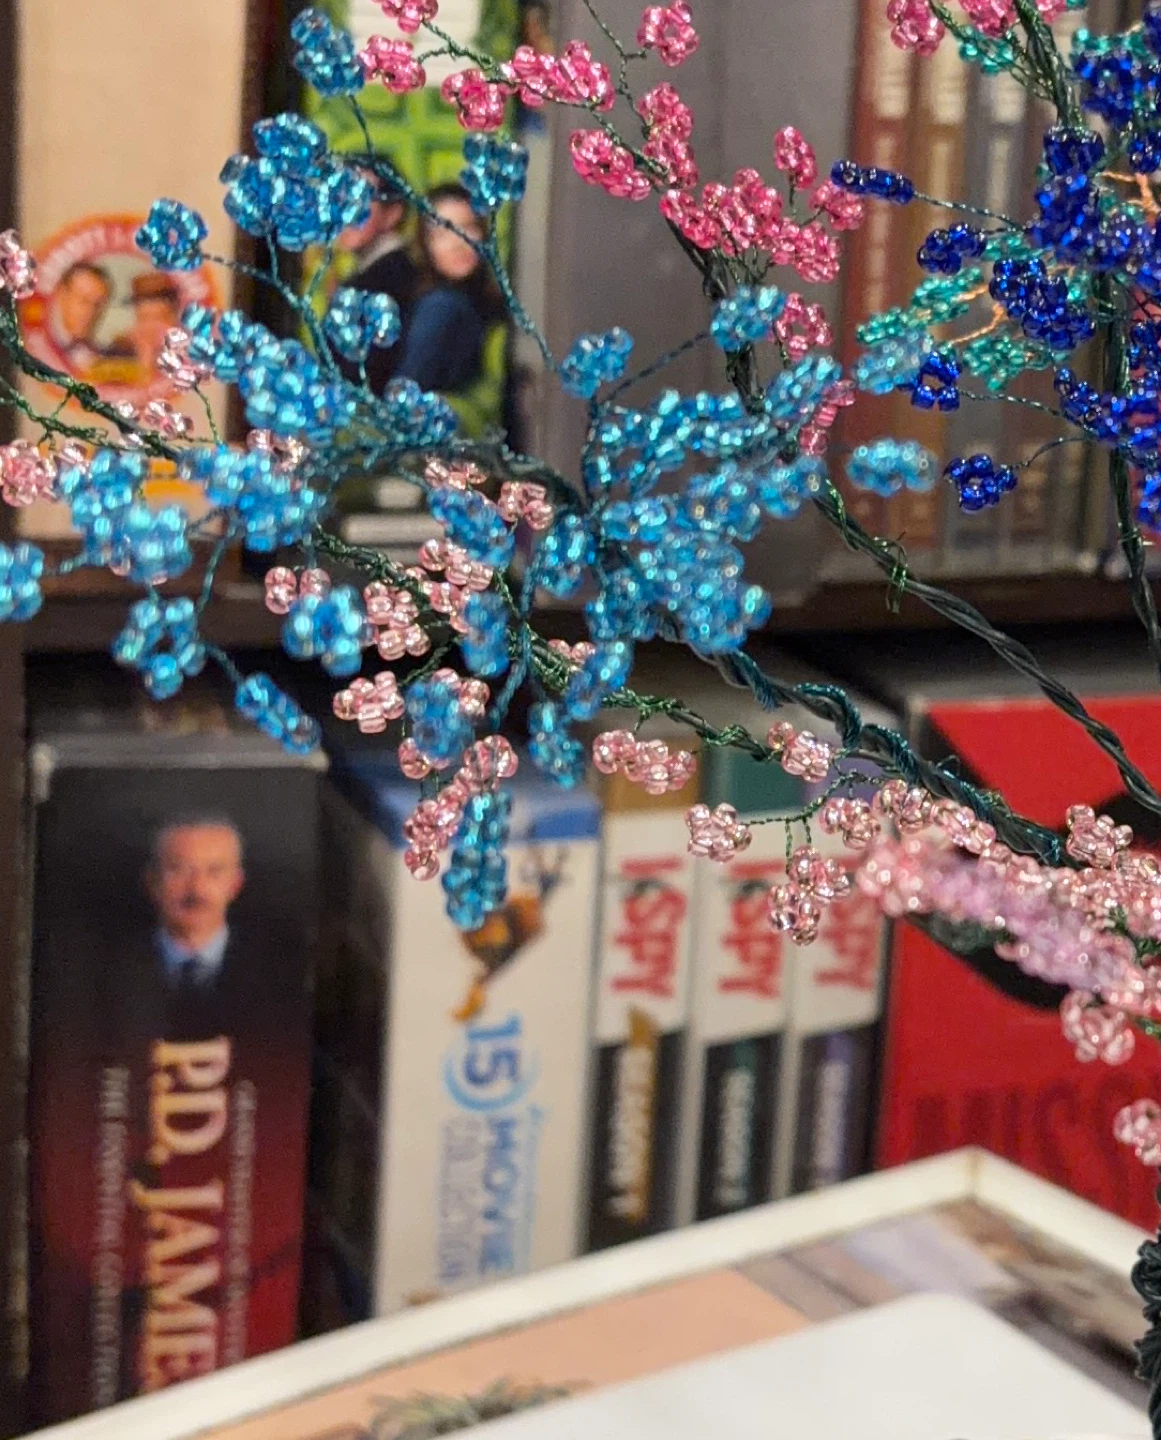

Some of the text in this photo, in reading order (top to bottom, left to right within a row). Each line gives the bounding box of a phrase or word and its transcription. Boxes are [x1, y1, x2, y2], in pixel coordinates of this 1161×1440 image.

[609, 888, 690, 1000] SPY
[717, 894, 787, 1001] SPY
[149, 1036, 231, 1165] P.D.
[463, 1012, 524, 1087] 15
[480, 1116, 520, 1276] MOVIE
